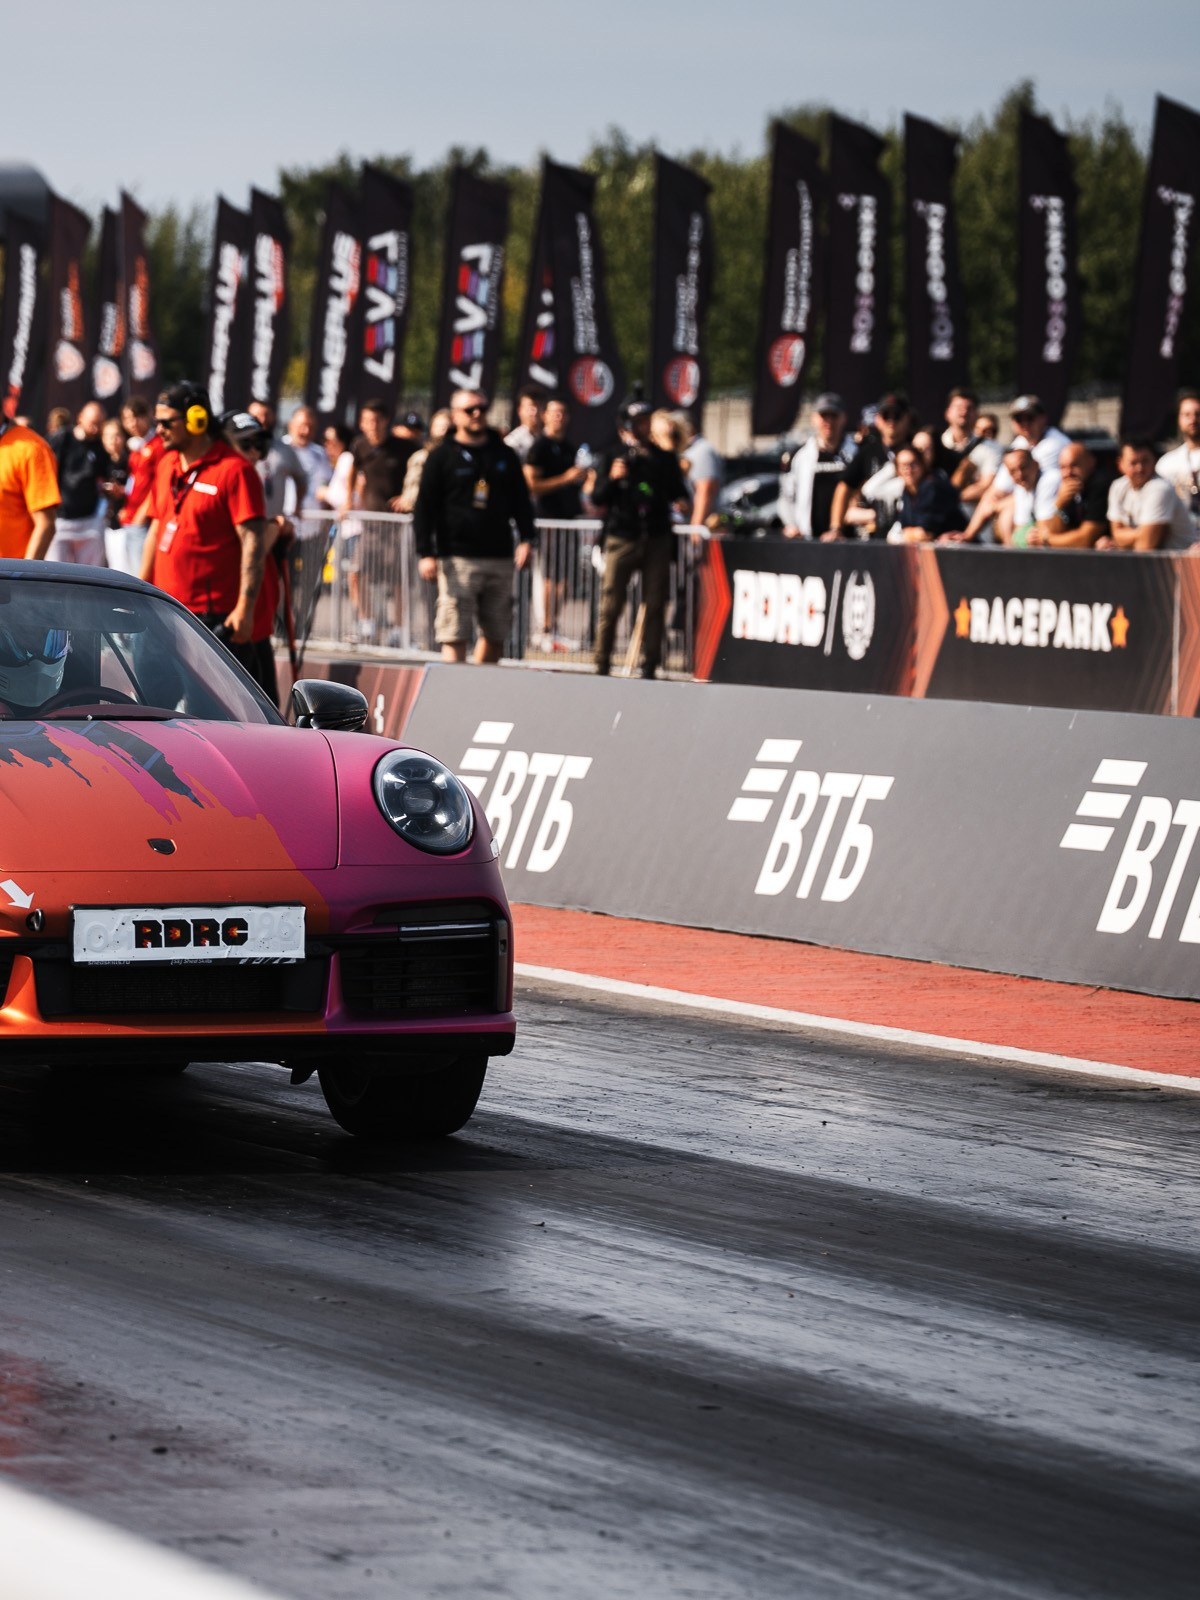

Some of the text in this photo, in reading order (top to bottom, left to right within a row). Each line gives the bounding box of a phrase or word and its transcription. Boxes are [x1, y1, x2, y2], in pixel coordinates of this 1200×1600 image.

[732, 568, 827, 648] RDRC
[969, 595, 1113, 652] RACEPARK
[485, 750, 593, 873] ВТБ
[754, 769, 895, 902] ВТБ
[1096, 796, 1200, 944] ВТ
[132, 917, 249, 949] RDRC
